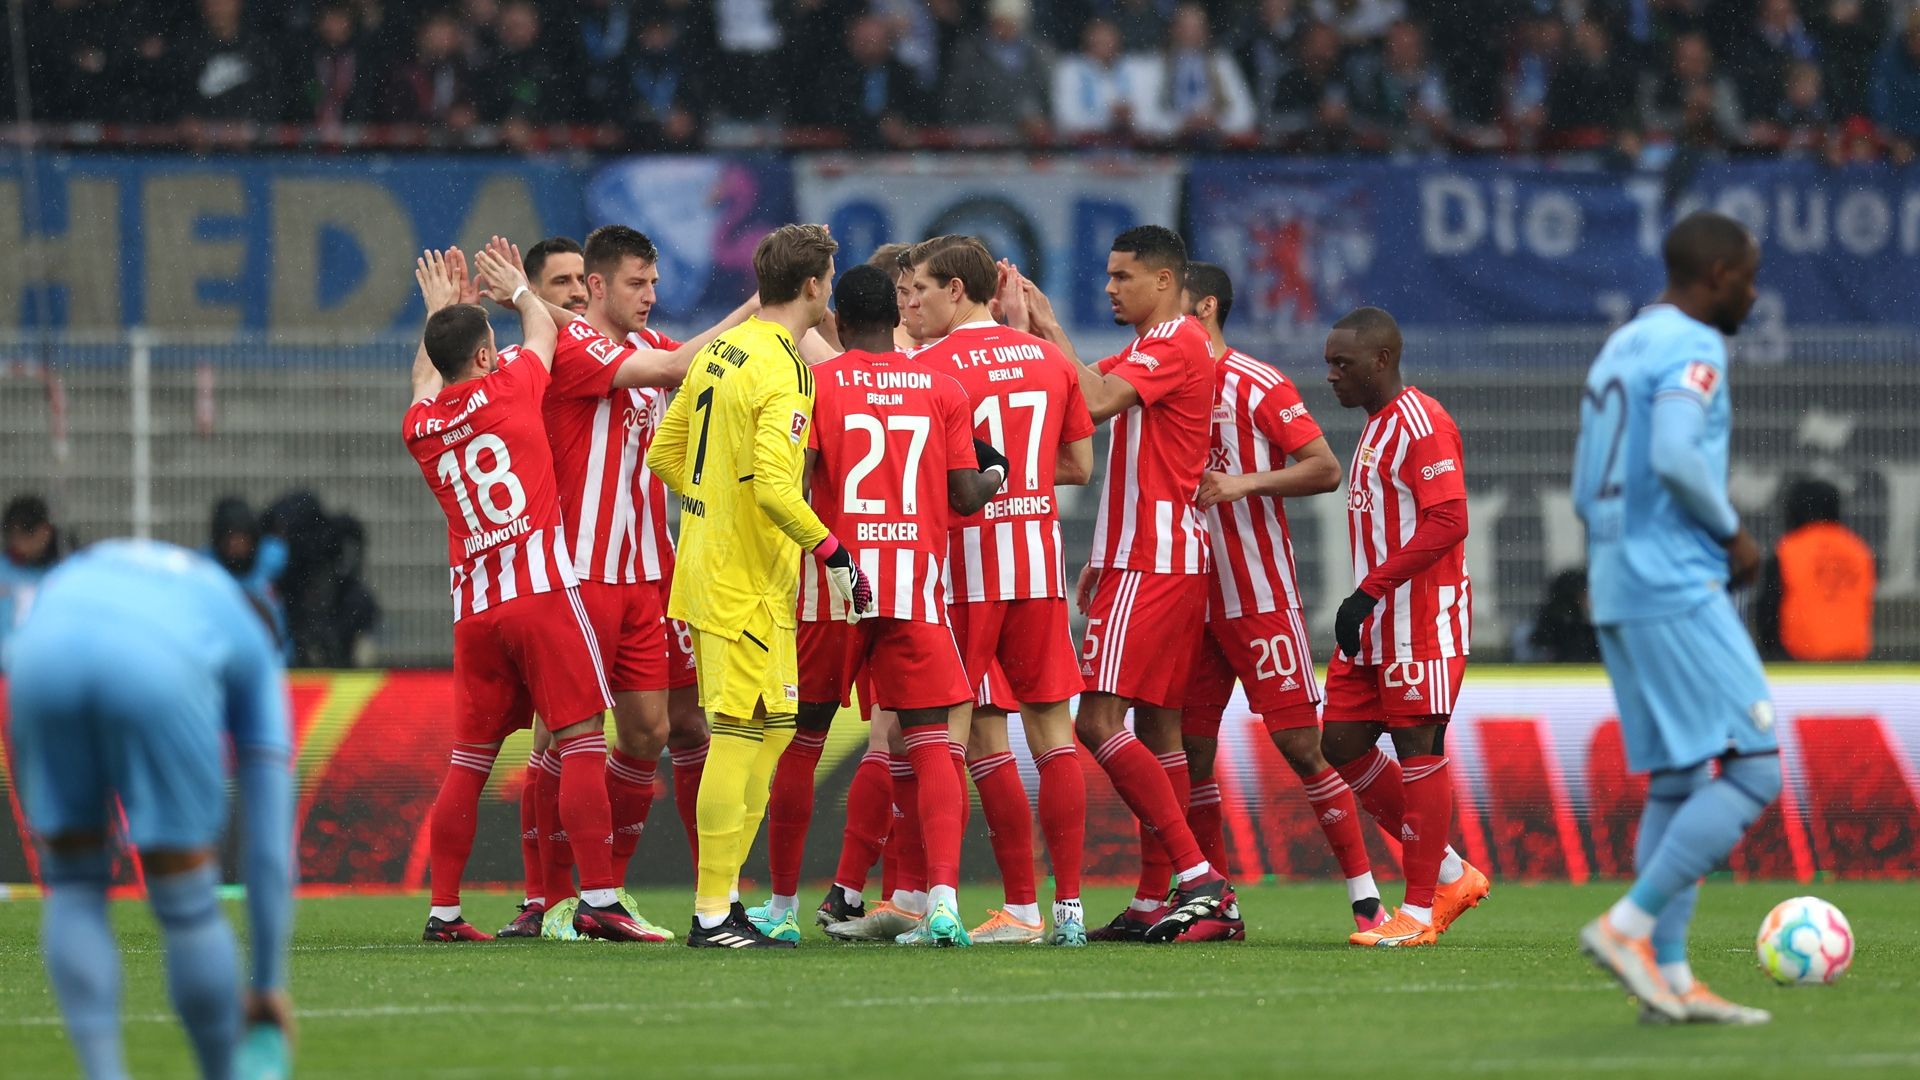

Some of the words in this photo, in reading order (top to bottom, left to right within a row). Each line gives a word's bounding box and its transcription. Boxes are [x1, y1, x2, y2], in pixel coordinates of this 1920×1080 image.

[708, 338, 726, 356] FC
[952, 353, 969, 370] 1.
[973, 349, 991, 367] FC
[996, 344, 1045, 364] UNION
[836, 370, 850, 387] 1.
[853, 371, 873, 387] FC
[877, 372, 932, 389] UNION
[988, 366, 1024, 382] BERLIN
[866, 393, 903, 405] BERLIN
[426, 418, 445, 435] FC
[442, 423, 474, 446] BERLIN
[692, 386, 714, 485] 1
[973, 390, 1048, 495] 17
[843, 413, 930, 515] 27
[1433, 459, 1454, 470] COMEDY
[1435, 465, 1457, 476] CENTRAL
[437, 433, 527, 534] 18
[984, 496, 1050, 520] BEHRENS
[464, 515, 531, 558] JURANOVIC
[857, 522, 918, 541] BECKER
[1083, 618, 1103, 660] 5
[1250, 634, 1298, 681] 20
